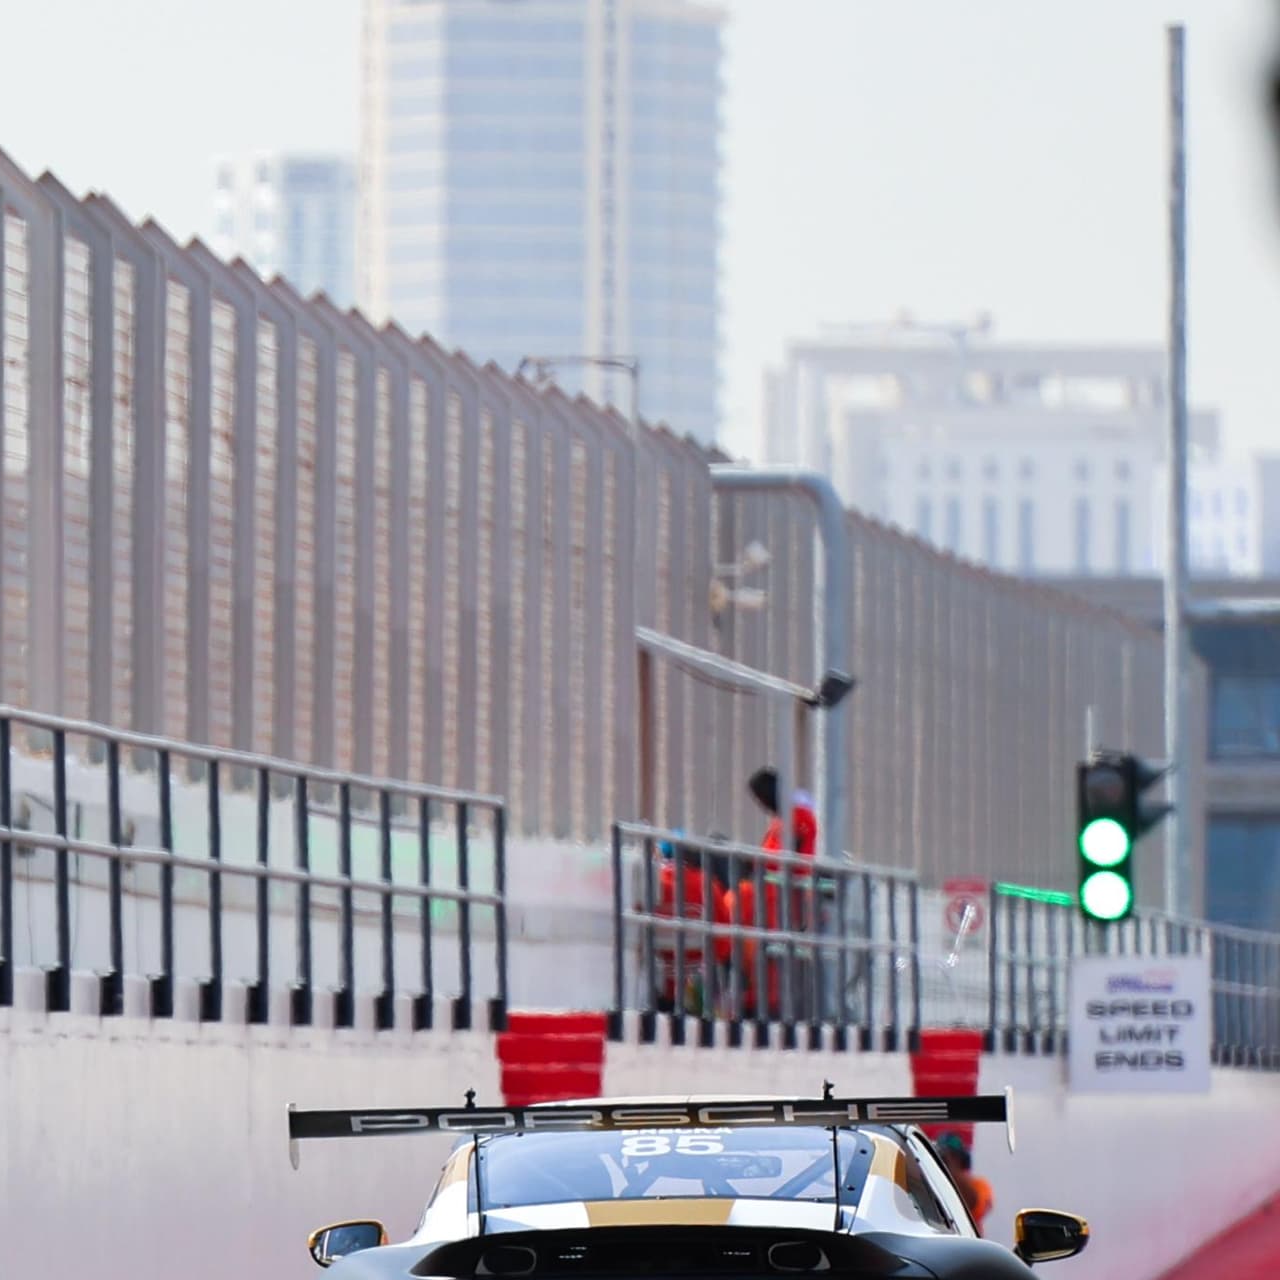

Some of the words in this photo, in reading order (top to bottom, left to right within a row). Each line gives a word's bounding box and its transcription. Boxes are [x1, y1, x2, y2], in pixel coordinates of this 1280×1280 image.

[1086, 1000, 1194, 1019] SPEED
[1099, 1025, 1180, 1044] LIMIT
[1095, 1050, 1185, 1070] ENDS
[350, 1102, 949, 1132] PORSCHE
[620, 1135, 725, 1156] 85
